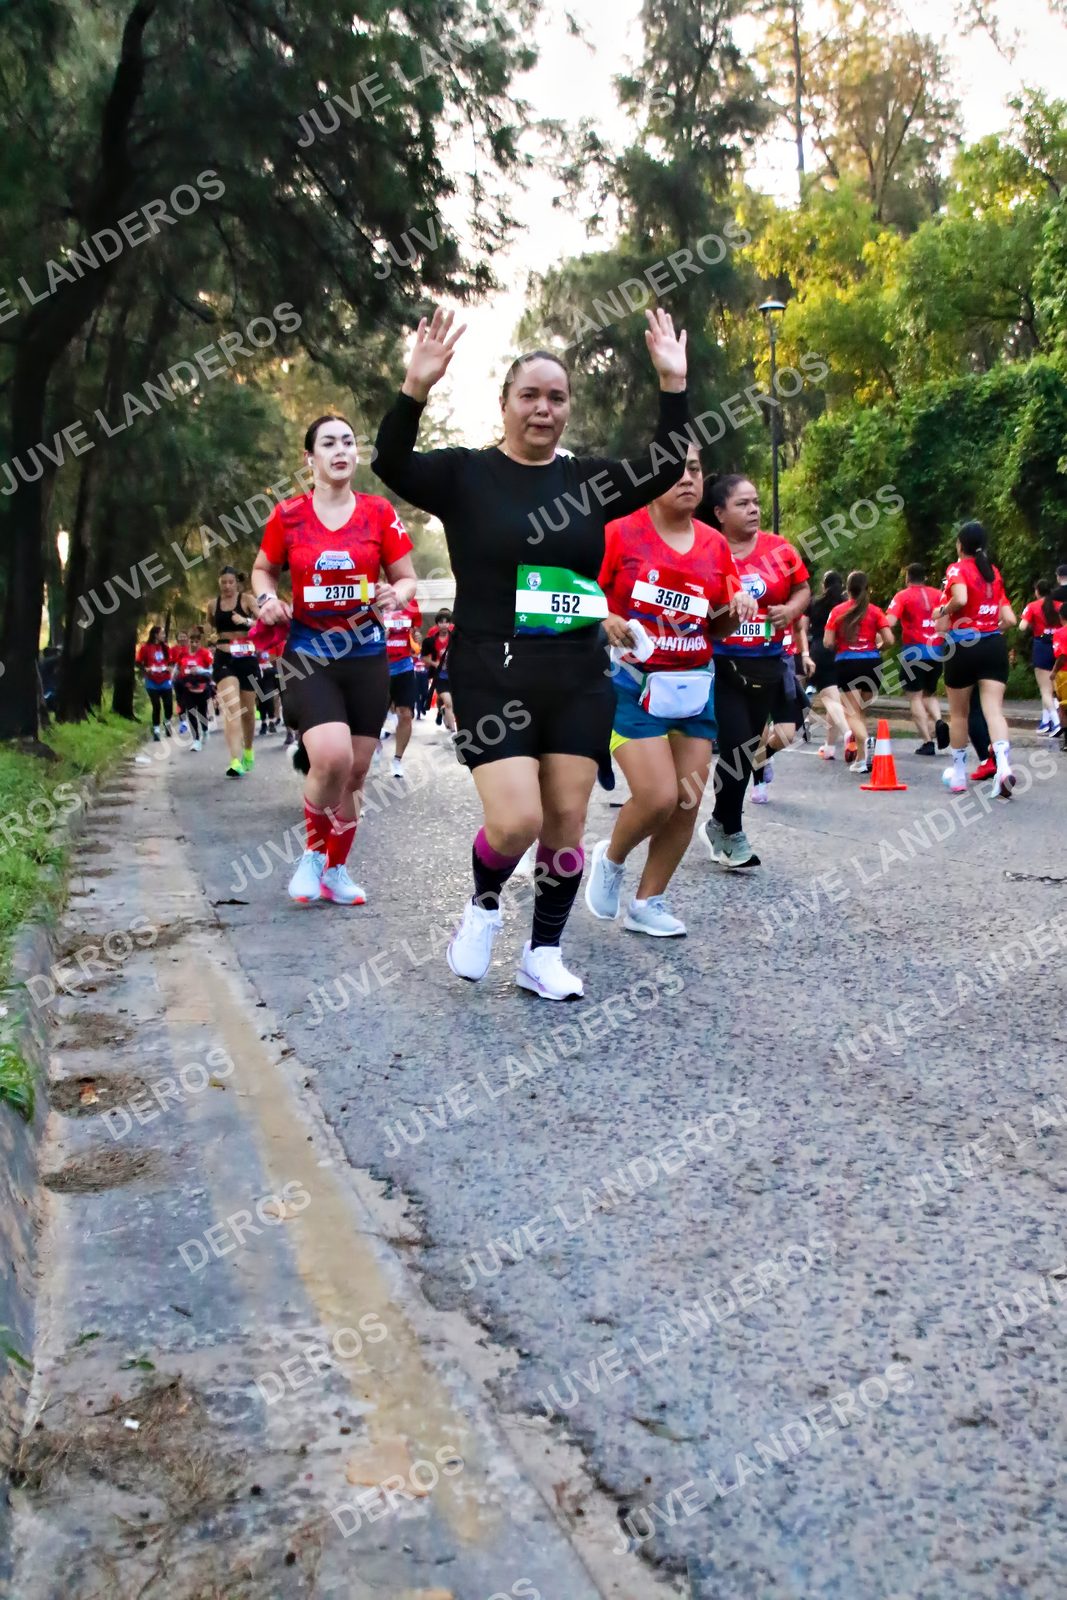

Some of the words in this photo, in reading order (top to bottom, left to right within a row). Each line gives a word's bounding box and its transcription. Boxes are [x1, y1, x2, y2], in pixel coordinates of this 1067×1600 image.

[325, 586, 354, 599] 2370
[655, 588, 690, 611] 3508
[551, 594, 580, 614] 552
